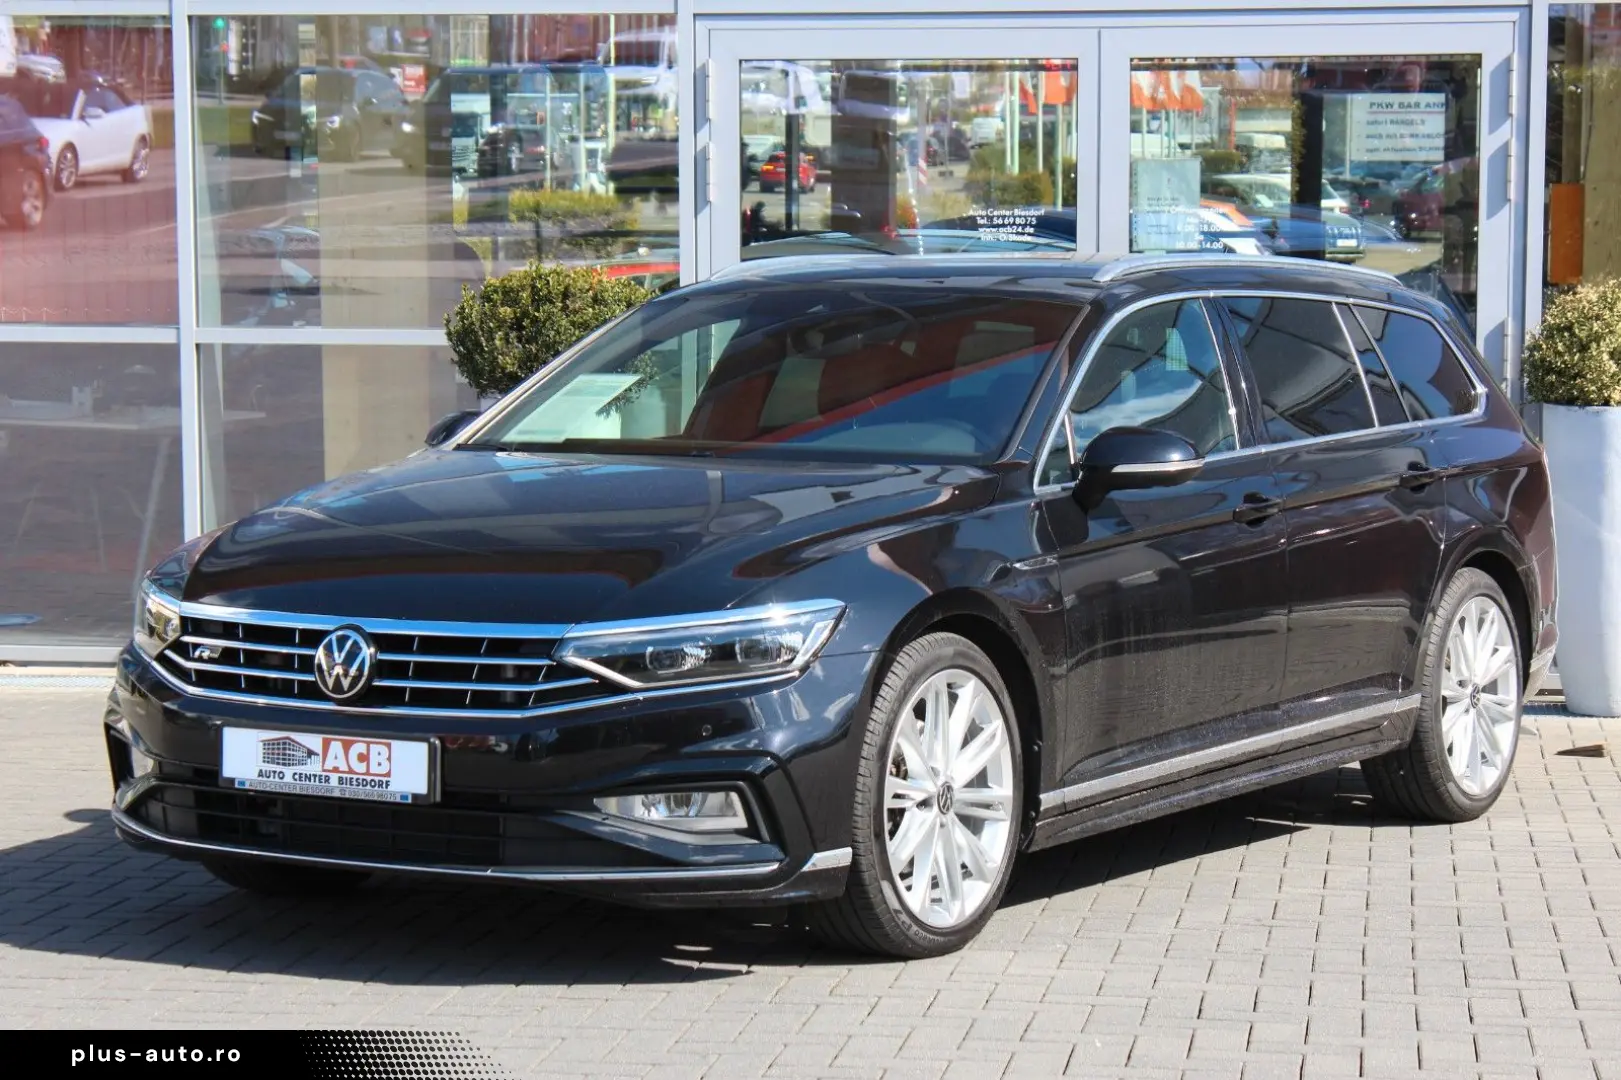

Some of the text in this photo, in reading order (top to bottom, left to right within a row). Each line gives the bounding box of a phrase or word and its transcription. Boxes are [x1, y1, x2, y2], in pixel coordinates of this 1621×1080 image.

[1369, 101, 1394, 109] PKW
[1398, 101, 1421, 109] BAR
[968, 208, 1045, 217] Auto Center Biesdorf
[323, 740, 391, 775] ACB
[256, 768, 391, 790] AUTO CENTER BIESDORF
